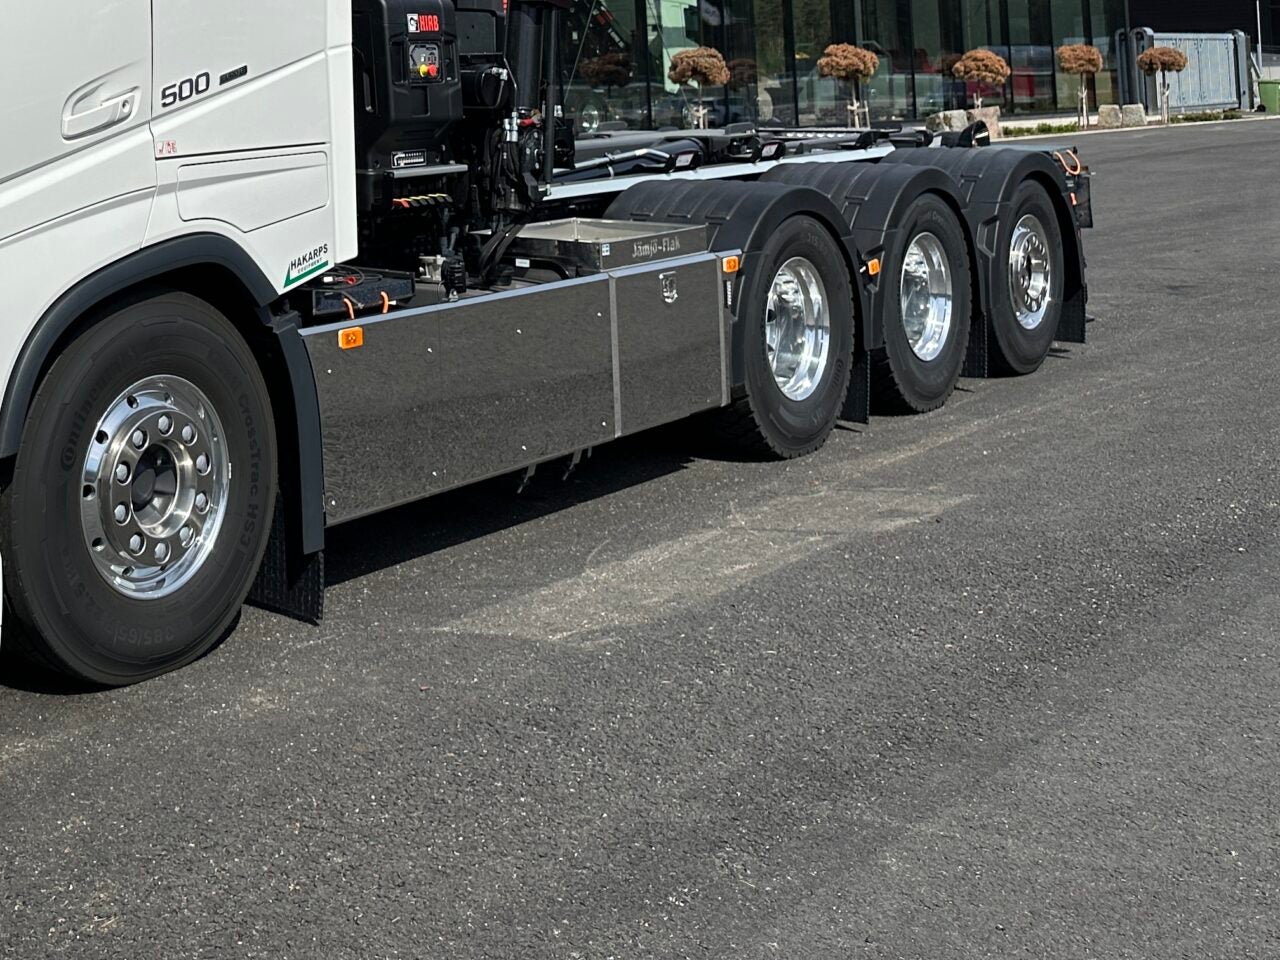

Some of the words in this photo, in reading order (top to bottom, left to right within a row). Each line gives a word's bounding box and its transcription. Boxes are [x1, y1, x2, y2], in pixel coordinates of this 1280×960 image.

[419, 14, 439, 32] HIAB
[161, 71, 210, 108] 500
[290, 243, 328, 271] HAKARPS
